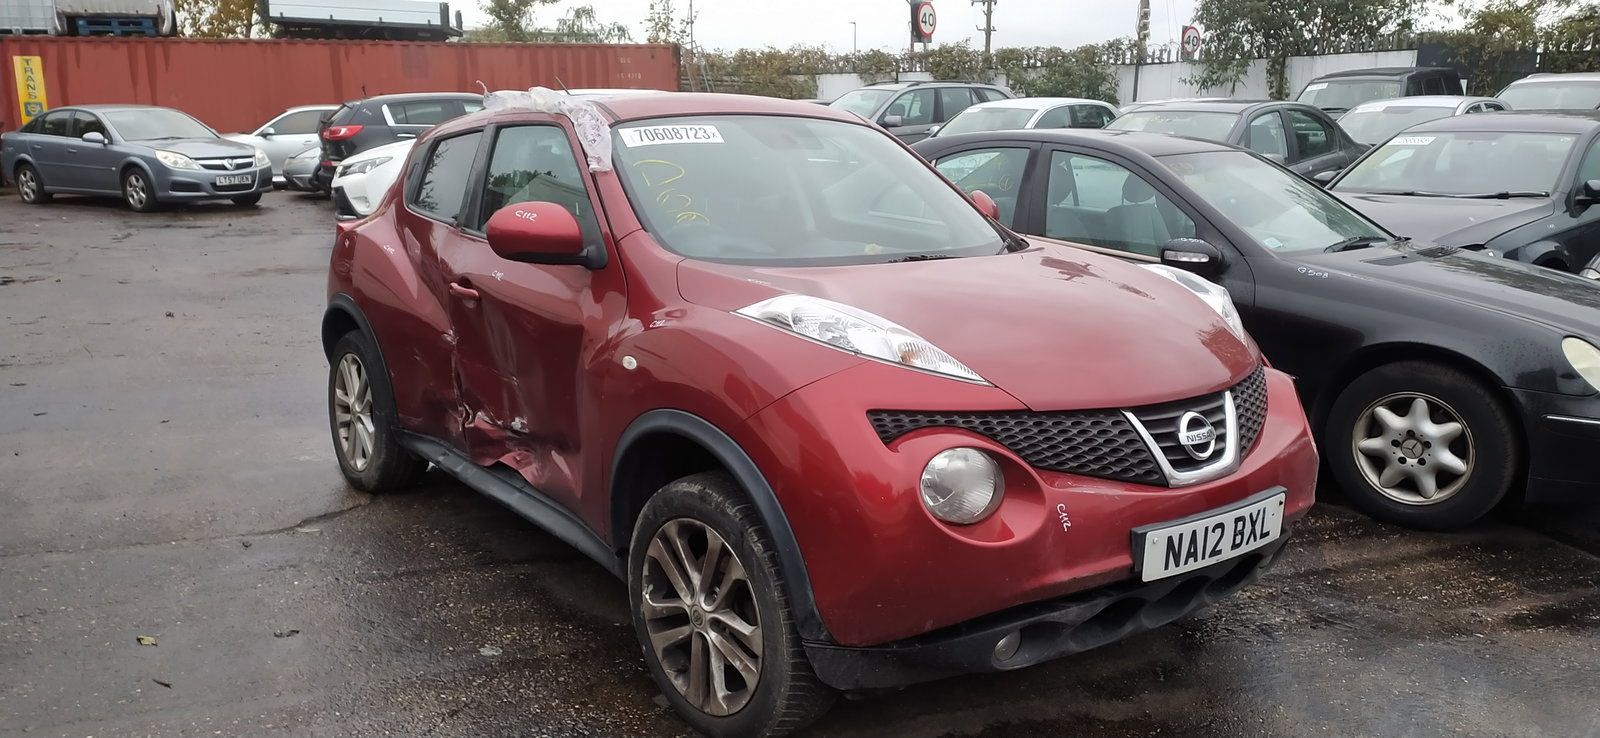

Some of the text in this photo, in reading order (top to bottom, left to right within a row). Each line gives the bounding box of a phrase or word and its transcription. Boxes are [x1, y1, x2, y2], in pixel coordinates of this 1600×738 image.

[921, 12, 935, 27] 40
[1184, 35, 1198, 47] 40
[23, 58, 37, 99] TRANS
[515, 210, 537, 222] C112
[1186, 428, 1215, 442] NISSAN
[1056, 503, 1071, 532] C112
[1164, 507, 1270, 571] NA12 BXL
